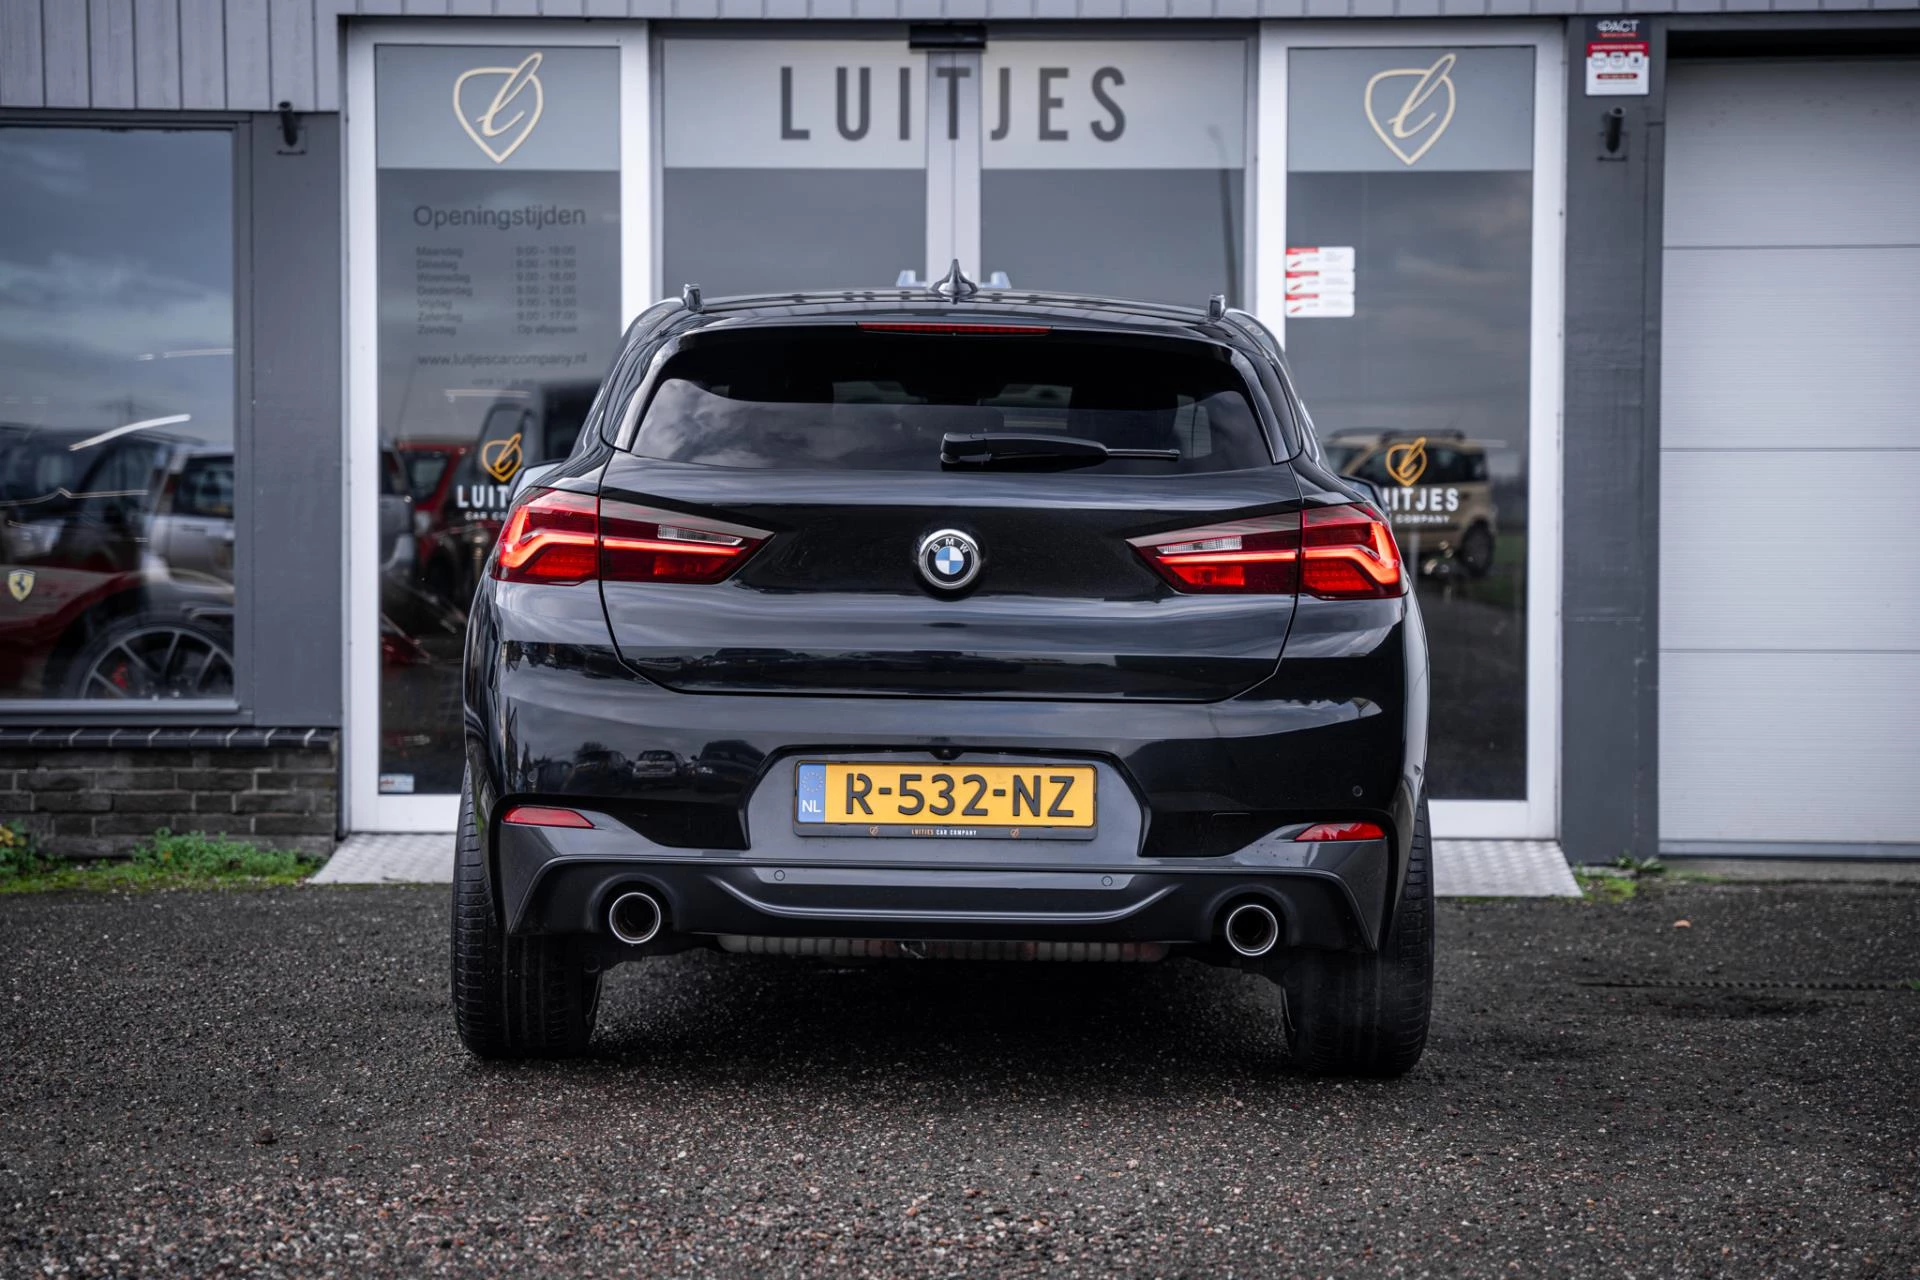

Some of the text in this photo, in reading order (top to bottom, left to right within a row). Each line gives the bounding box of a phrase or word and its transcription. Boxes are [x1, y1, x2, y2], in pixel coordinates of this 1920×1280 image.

[780, 66, 1127, 142] LUITJES
[413, 204, 586, 230] Openingstijden
[457, 485, 509, 508] LUIT
[1383, 488, 1459, 511] ITJES
[1395, 514, 1450, 523] COMPANY
[931, 538, 969, 553] BMW
[802, 800, 821, 813] NL
[845, 773, 1075, 817] R-532-NZ
